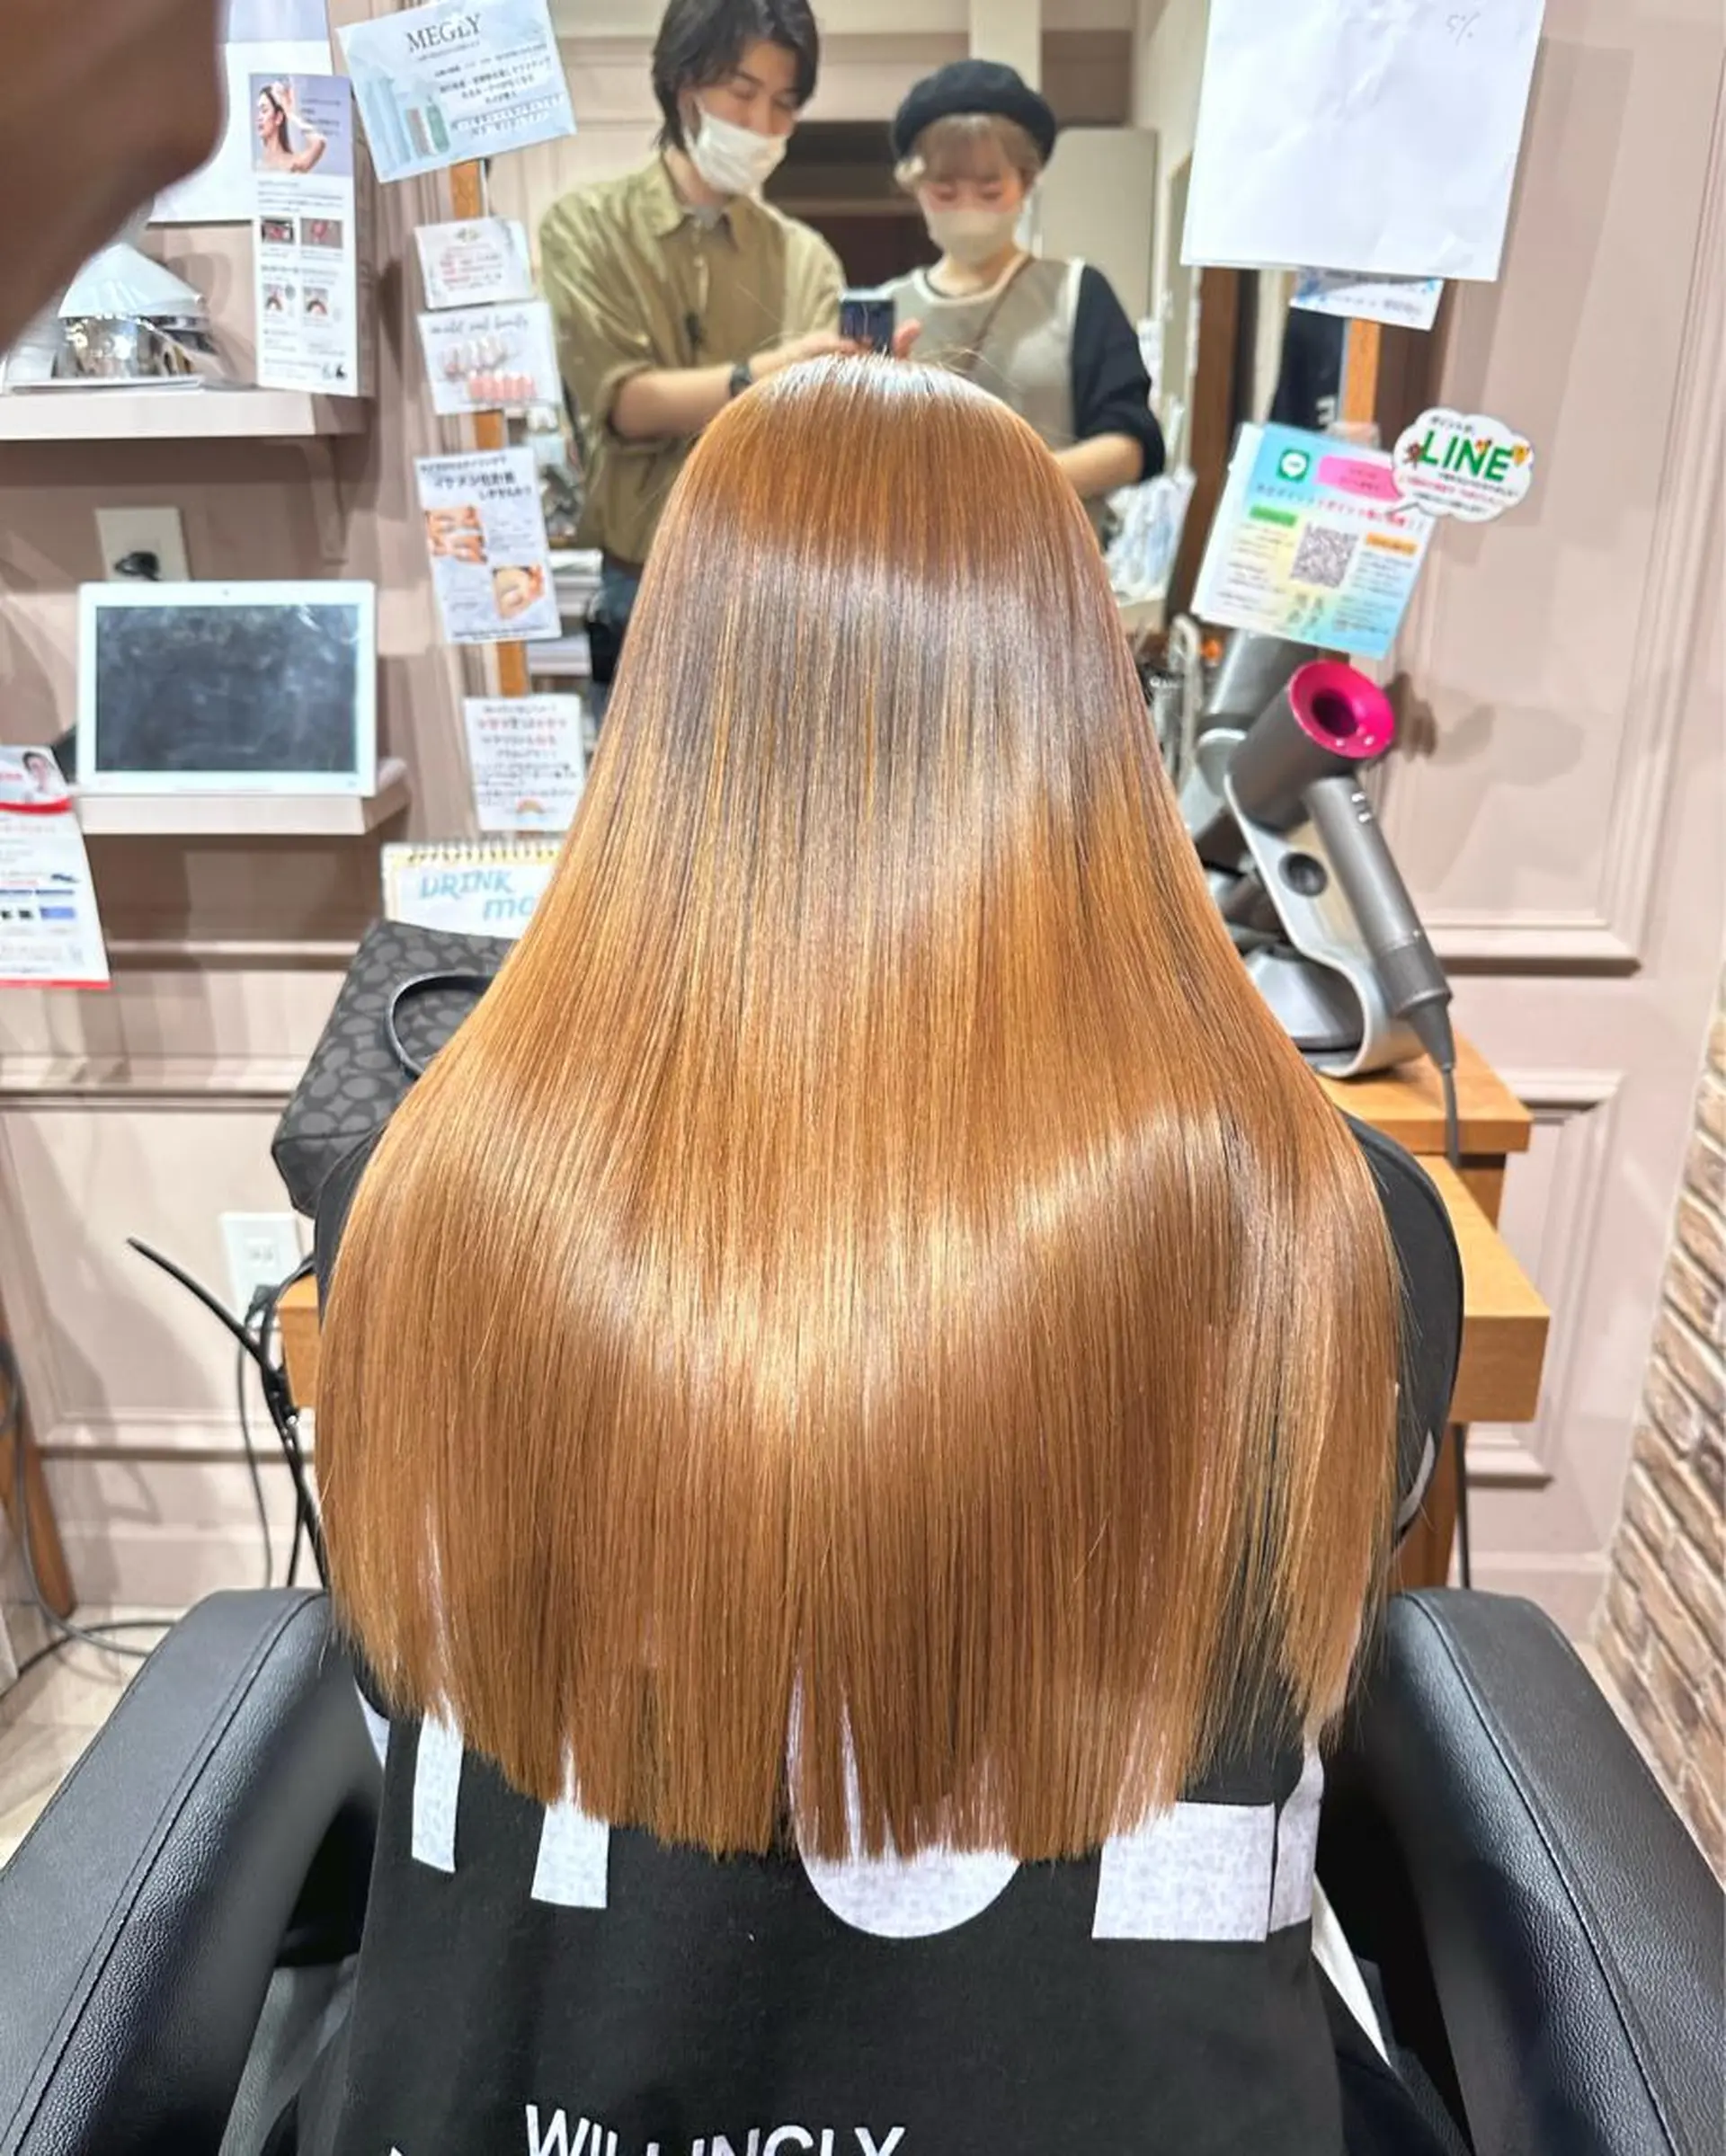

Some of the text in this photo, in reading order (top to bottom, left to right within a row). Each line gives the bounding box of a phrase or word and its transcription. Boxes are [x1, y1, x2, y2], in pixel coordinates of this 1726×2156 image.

[1446, 11, 1481, 46] 5%
[1419, 430, 1512, 482] LINE
[419, 870, 516, 901] DRINK
[524, 2103, 906, 2156] WILGLY
